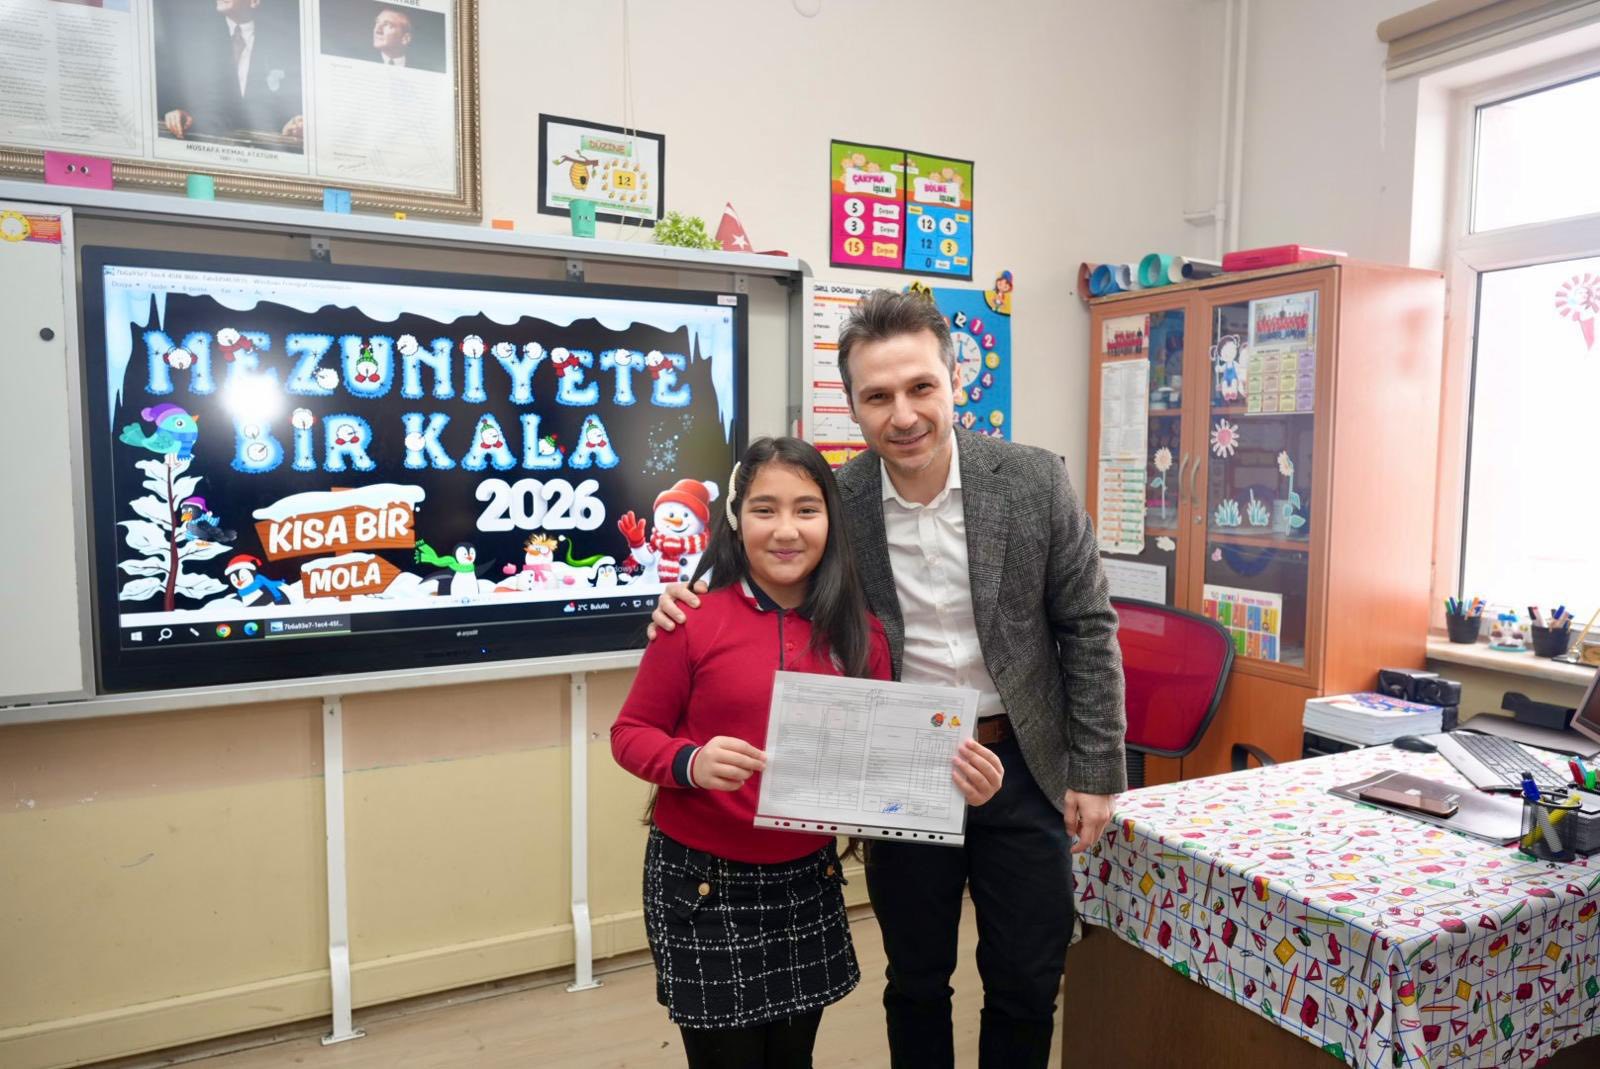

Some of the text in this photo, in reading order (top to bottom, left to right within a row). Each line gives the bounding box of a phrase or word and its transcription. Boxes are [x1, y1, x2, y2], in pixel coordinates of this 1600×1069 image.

[618, 174, 632, 186] 12
[852, 202, 858, 213] 5
[851, 220, 858, 232] 3
[921, 218, 933, 230] 12
[945, 221, 952, 232] 4
[848, 241, 860, 252] 15
[921, 238, 932, 249] 12
[946, 241, 953, 253] 3
[984, 333, 993, 347] 2
[981, 372, 992, 386] 4
[971, 387, 982, 400] 5
[402, 413, 620, 472] KALA
[475, 478, 606, 532] 2026
[269, 515, 349, 554] KISA
[309, 562, 381, 594] MOLA
